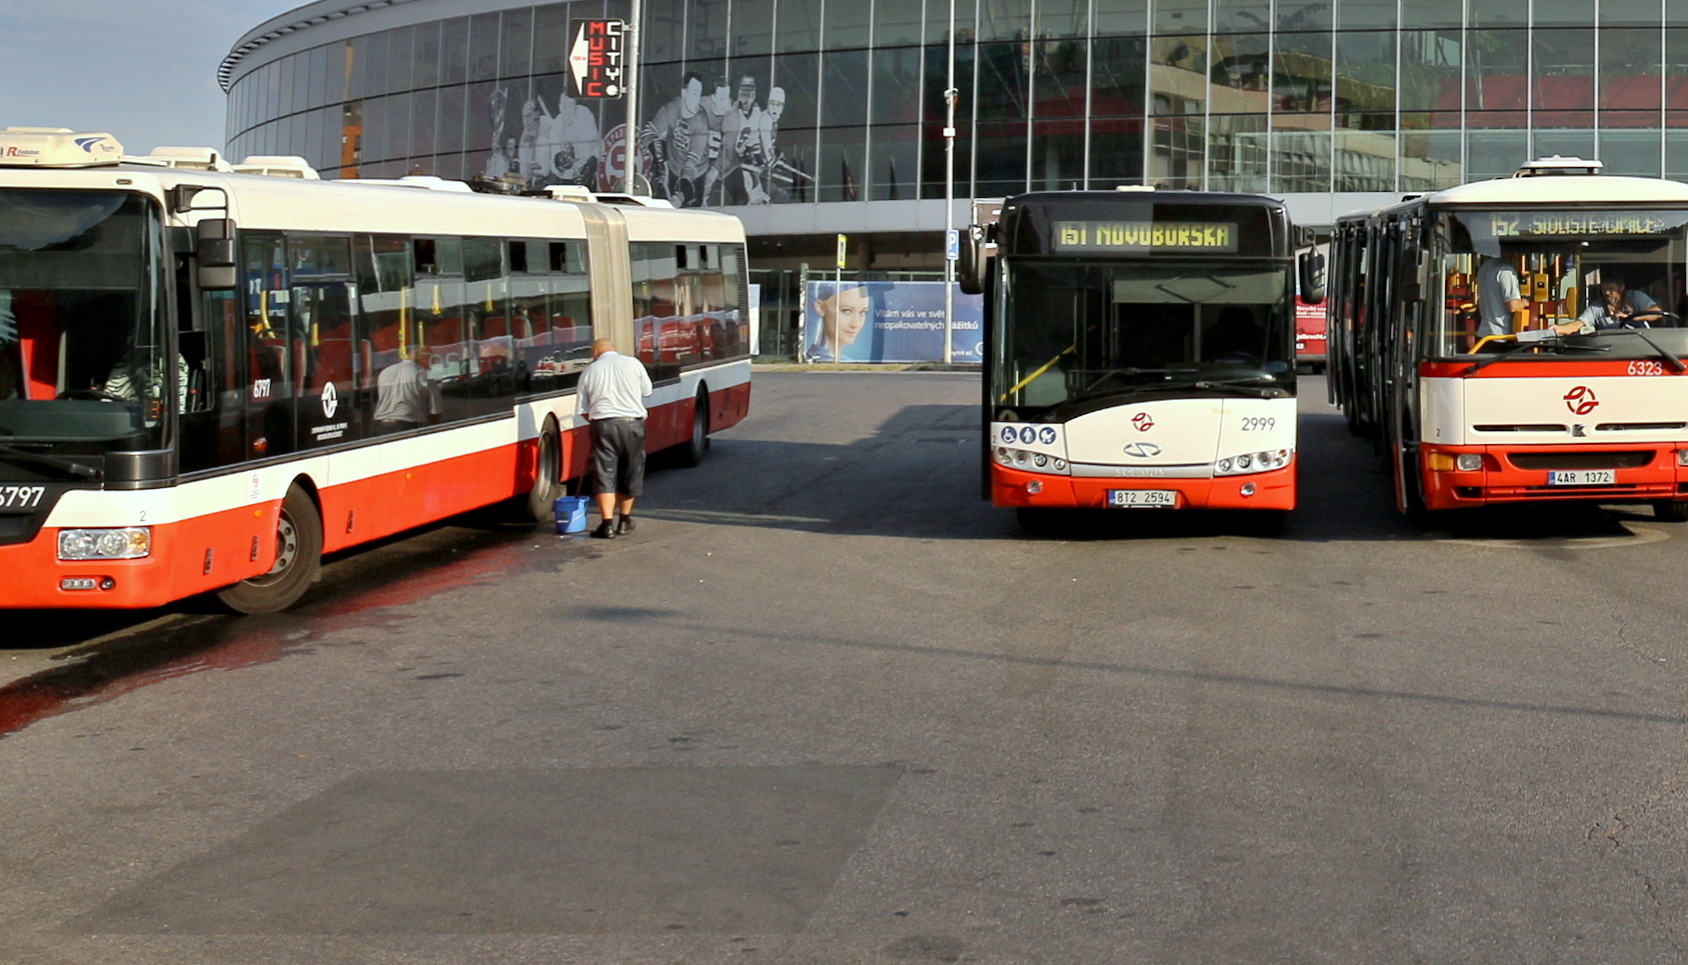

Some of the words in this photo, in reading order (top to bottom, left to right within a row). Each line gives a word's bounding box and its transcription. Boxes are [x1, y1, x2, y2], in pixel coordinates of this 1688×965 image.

[587, 22, 604, 96] MUSIC
[1491, 212, 1520, 236] 152
[1061, 221, 1086, 245] 151
[901, 309, 916, 318] vás
[951, 320, 979, 330] ážitků
[1627, 360, 1663, 376] 6323
[253, 378, 271, 398] 6797
[1241, 417, 1276, 432] 2999
[1557, 472, 1576, 483] 4AR
[1585, 472, 1610, 483] 1372
[1117, 491, 1137, 504] 8T2
[1144, 491, 1170, 504] 2594
[139, 510, 147, 523] 2
